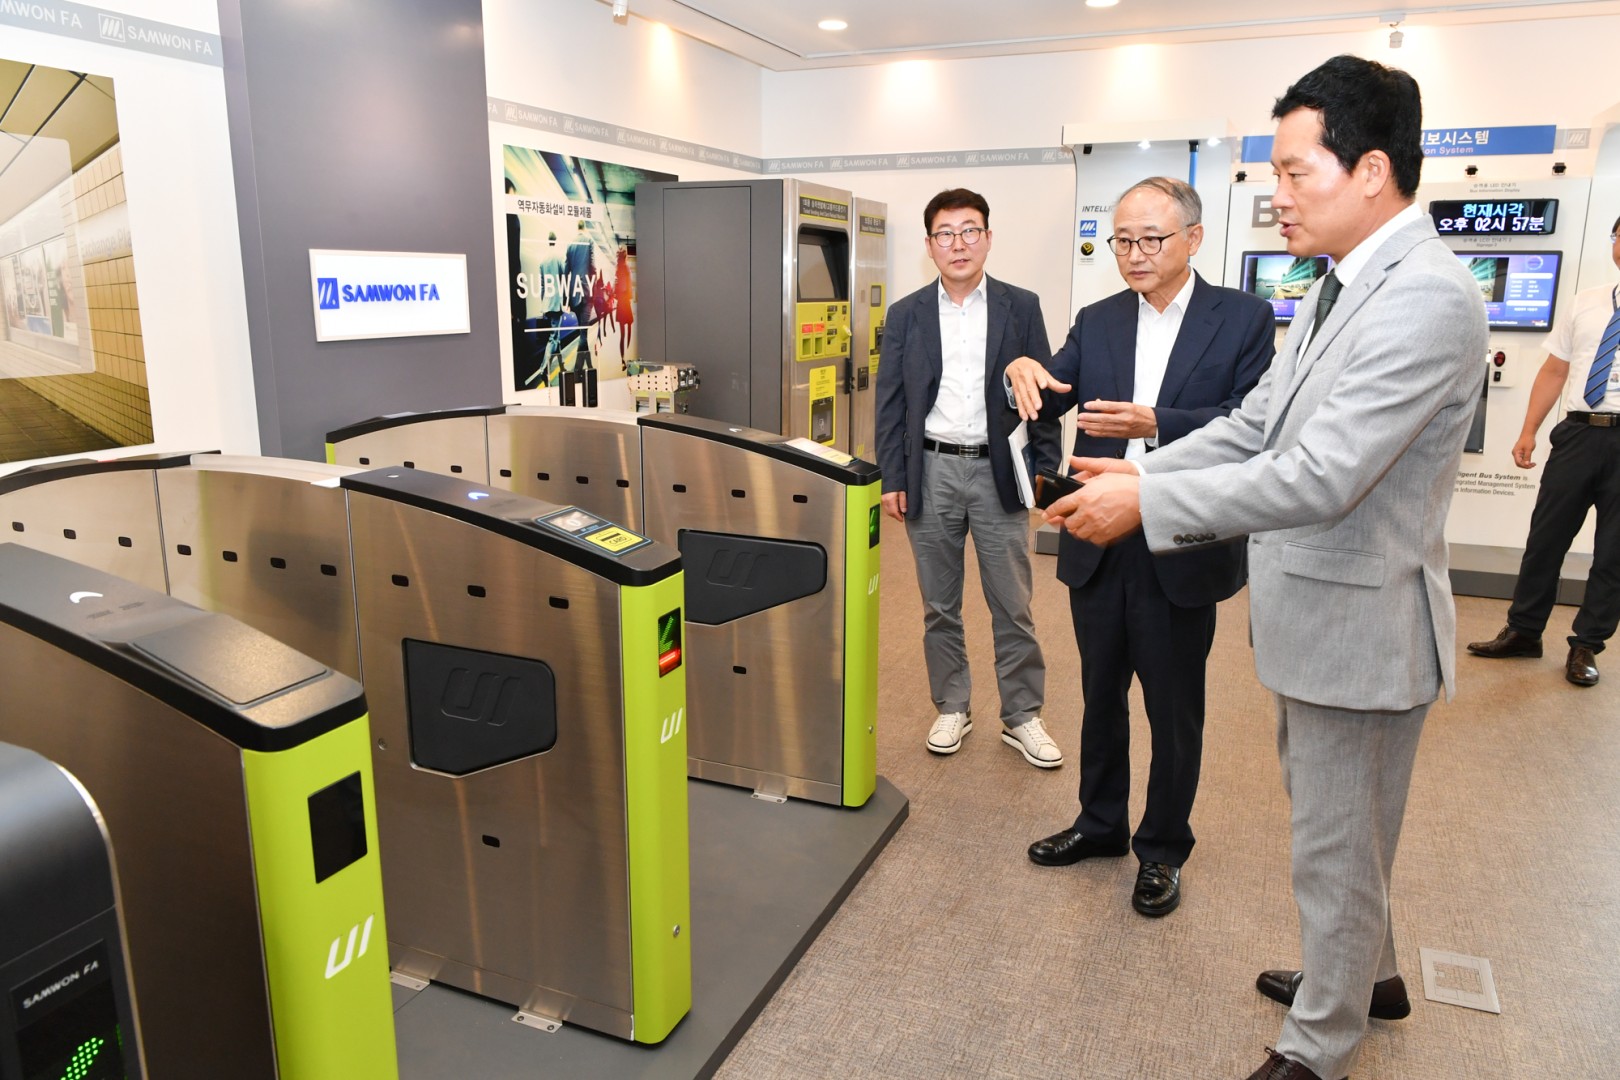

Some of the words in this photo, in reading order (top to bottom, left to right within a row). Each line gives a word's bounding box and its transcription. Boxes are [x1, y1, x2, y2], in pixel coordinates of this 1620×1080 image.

[61, 11, 83, 29] FA
[127, 25, 192, 51] SAMWON
[195, 39, 214, 56] FA
[518, 109, 549, 126] SAMWON
[549, 117, 558, 128] FA
[575, 121, 600, 136] SAMWON
[601, 127, 609, 138] FA
[626, 134, 649, 147] SAMWON
[980, 153, 1016, 163] SAMWON
[1018, 152, 1029, 161] FA
[1439, 146, 1474, 156] System
[781, 161, 813, 170] SAMWON
[814, 160, 824, 169] FA
[843, 159, 877, 168] SAMWON
[878, 157, 888, 166] FA
[910, 156, 945, 165] SAMWON
[946, 155, 958, 164] FA
[1252, 195, 1280, 228] B
[1463, 203, 1525, 218] 현재시각
[1438, 217, 1469, 232] 오후
[1474, 217, 1505, 232] 02시
[1511, 217, 1545, 232] 57분
[342, 284, 417, 302] SAMWON
[419, 284, 441, 301] FA
[517, 272, 596, 299] SUBWAY
[1460, 487, 1491, 495] Information
[1478, 480, 1514, 488] Management
[1514, 482, 1536, 490] System
[609, 536, 627, 545] CARD
[23, 971, 80, 1009] SAMWON
[83, 960, 99, 975] FA
